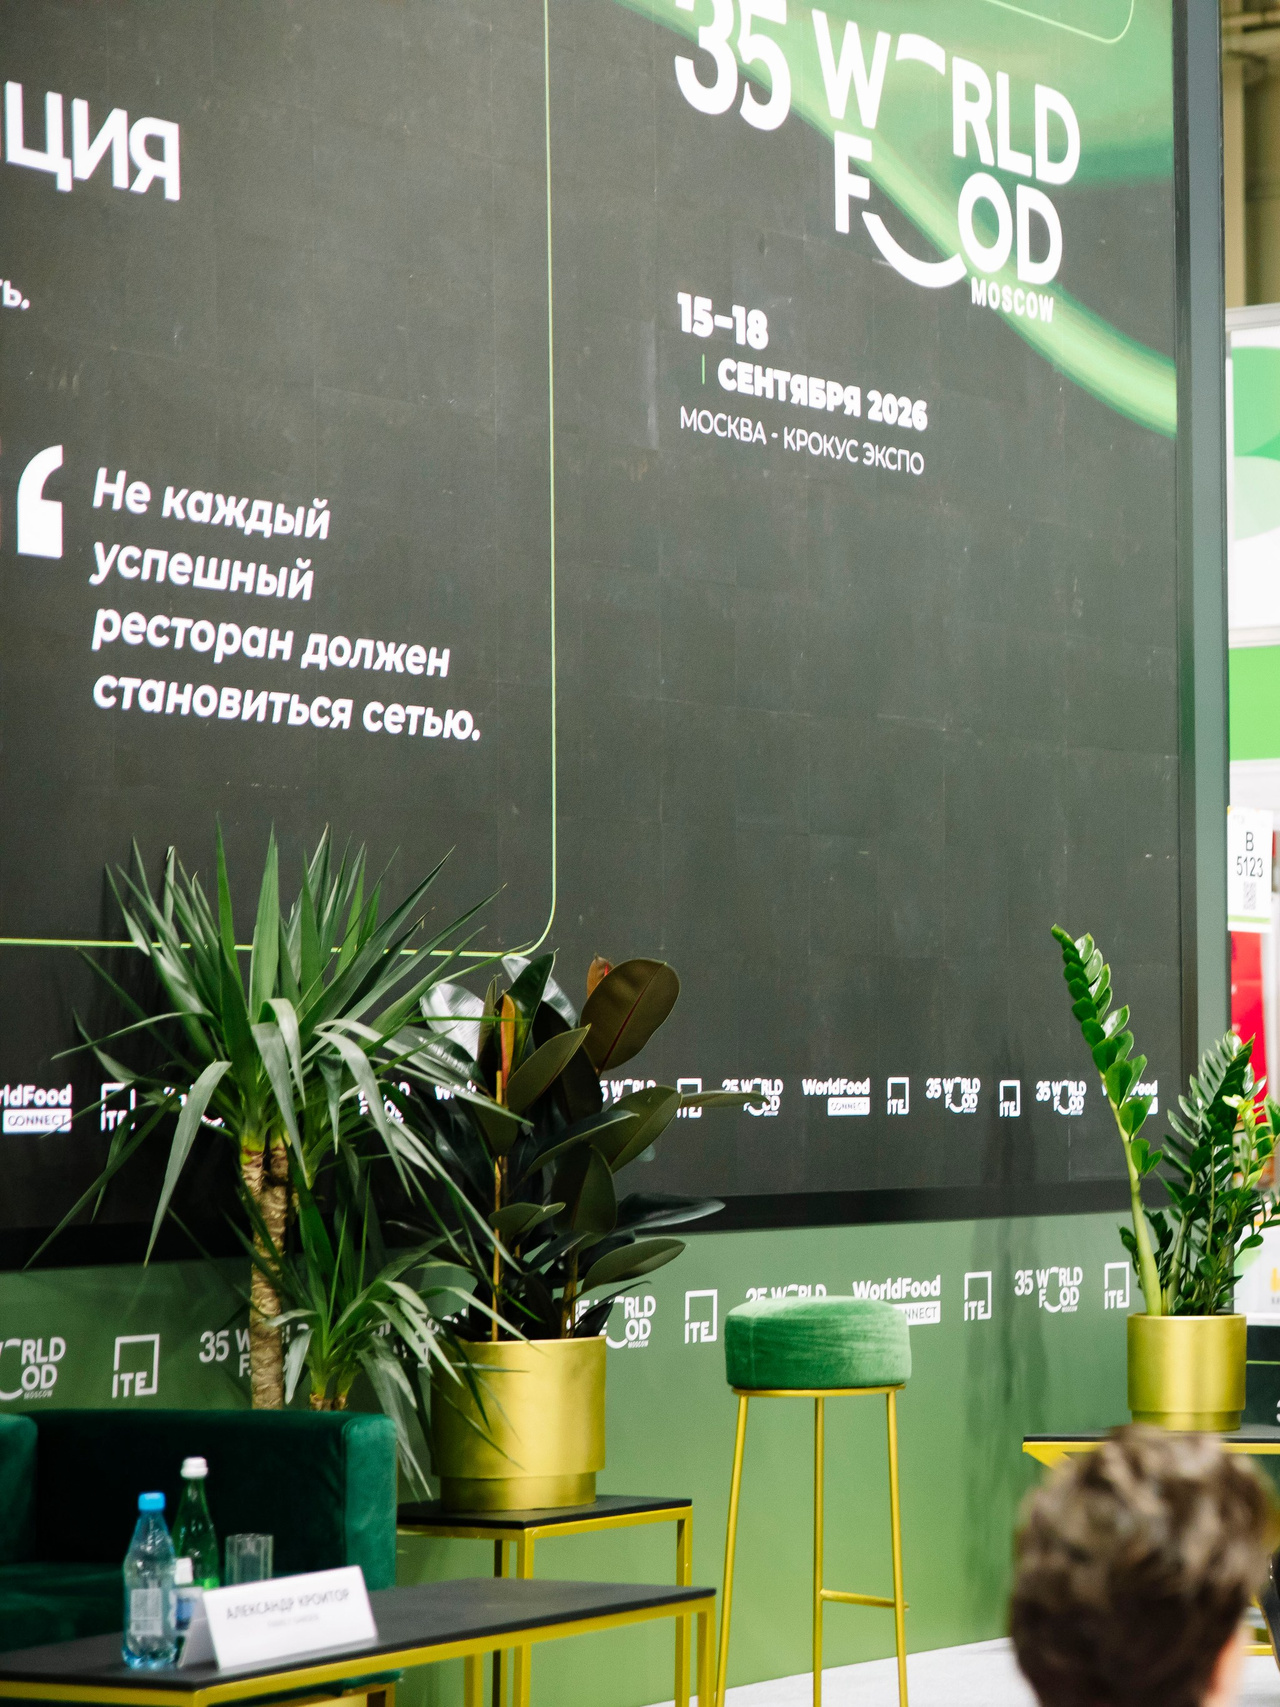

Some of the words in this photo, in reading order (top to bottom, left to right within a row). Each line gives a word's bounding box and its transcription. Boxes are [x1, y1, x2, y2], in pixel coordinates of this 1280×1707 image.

[675, 0, 791, 131] 35
[5, 81, 181, 201] ЦИЯ
[970, 276, 1055, 324] MOSCOW
[717, 358, 861, 417] СЕНТЯБРЯ
[867, 390, 928, 432] 2026
[680, 405, 767, 446] МОСКВА
[783, 426, 859, 465] КРОКУС
[862, 447, 925, 476] ЭКСПО
[92, 467, 151, 513] Не
[162, 484, 331, 539] каждый
[89, 541, 315, 600] успешный
[91, 607, 294, 663] ресторан
[300, 631, 451, 678] должен
[92, 673, 352, 729] становиться
[362, 700, 482, 742] сетью.
[1245, 831, 1255, 852] B
[1236, 855, 1264, 878] 5123
[802, 1077, 871, 1096] WorldFood
[926, 1077, 942, 1099] 35
[1035, 1080, 1051, 1101] 35
[7, 1114, 67, 1127] CONNECT
[852, 1274, 941, 1301] WorldFood
[1014, 1269, 1034, 1297] 35
[904, 1306, 938, 1321] NNECT
[199, 1330, 230, 1363] 35
